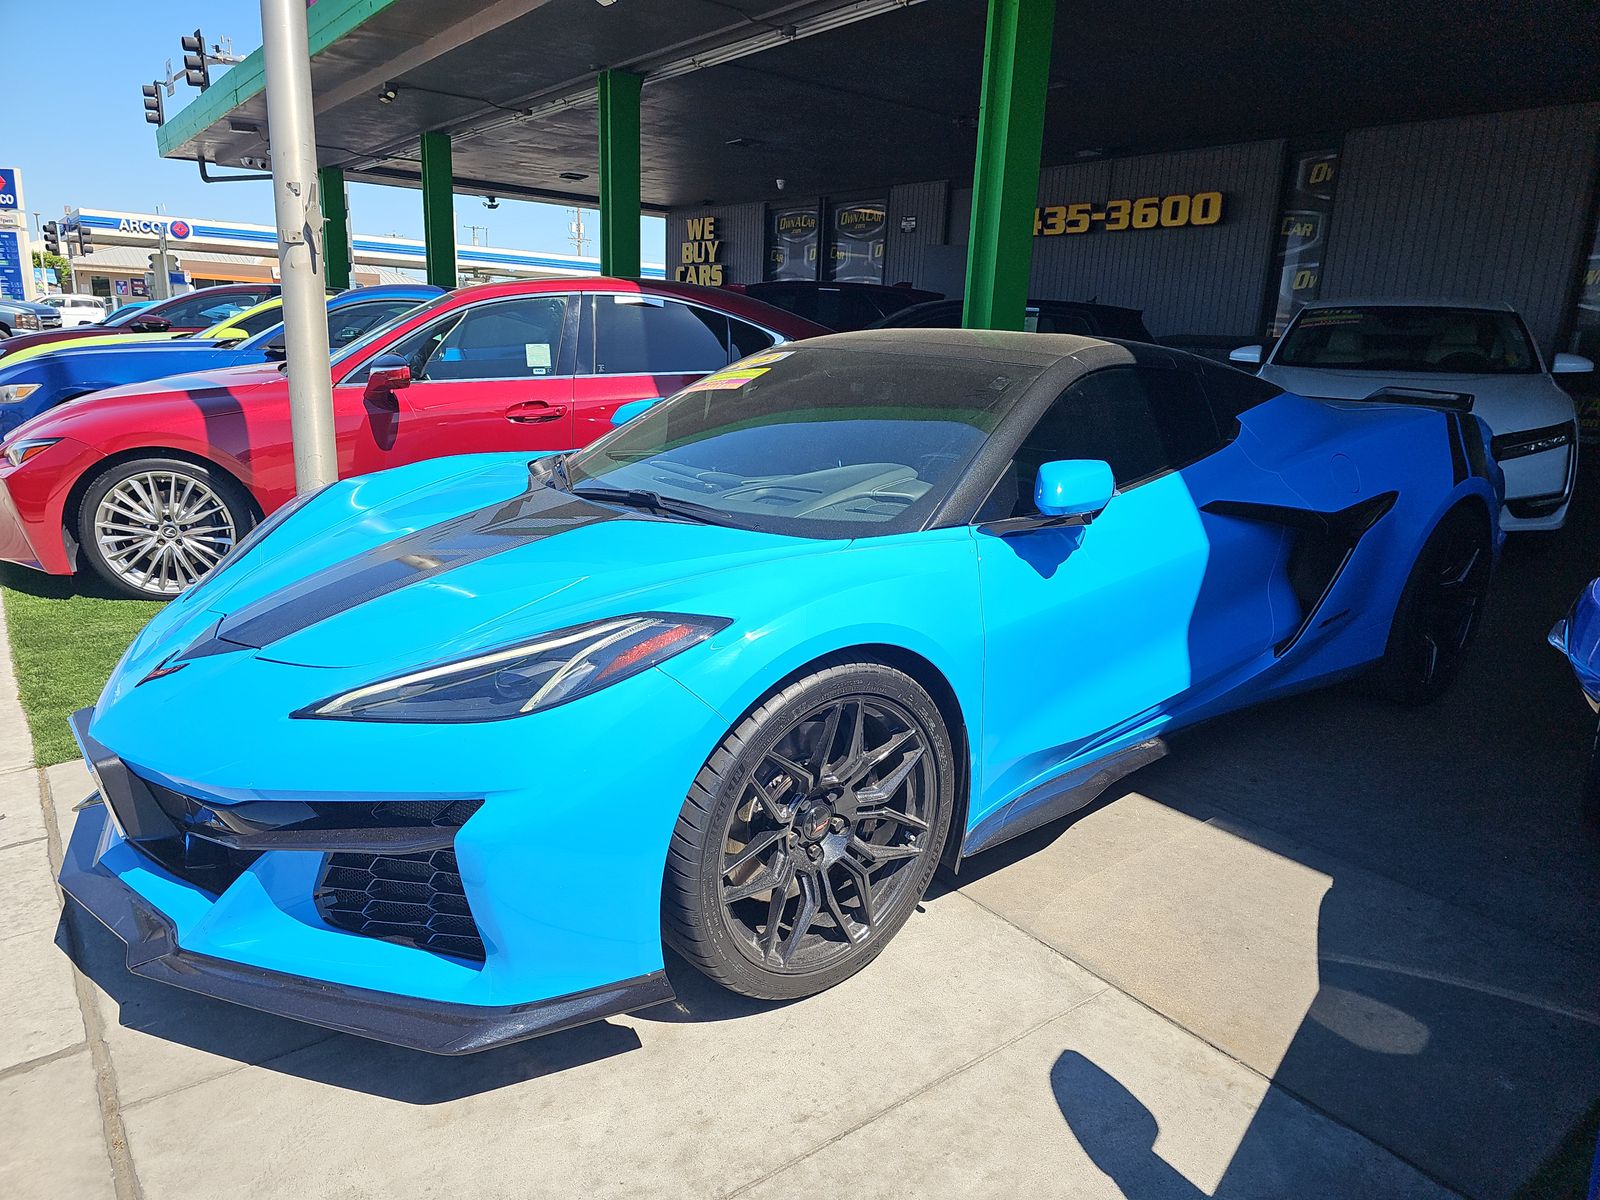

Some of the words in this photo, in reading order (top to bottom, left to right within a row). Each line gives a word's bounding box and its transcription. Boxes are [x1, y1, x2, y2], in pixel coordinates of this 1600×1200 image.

[119, 219, 161, 234] ARCO
[687, 217, 714, 240] WE
[681, 240, 719, 263] BUY
[675, 264, 722, 287] CARS
